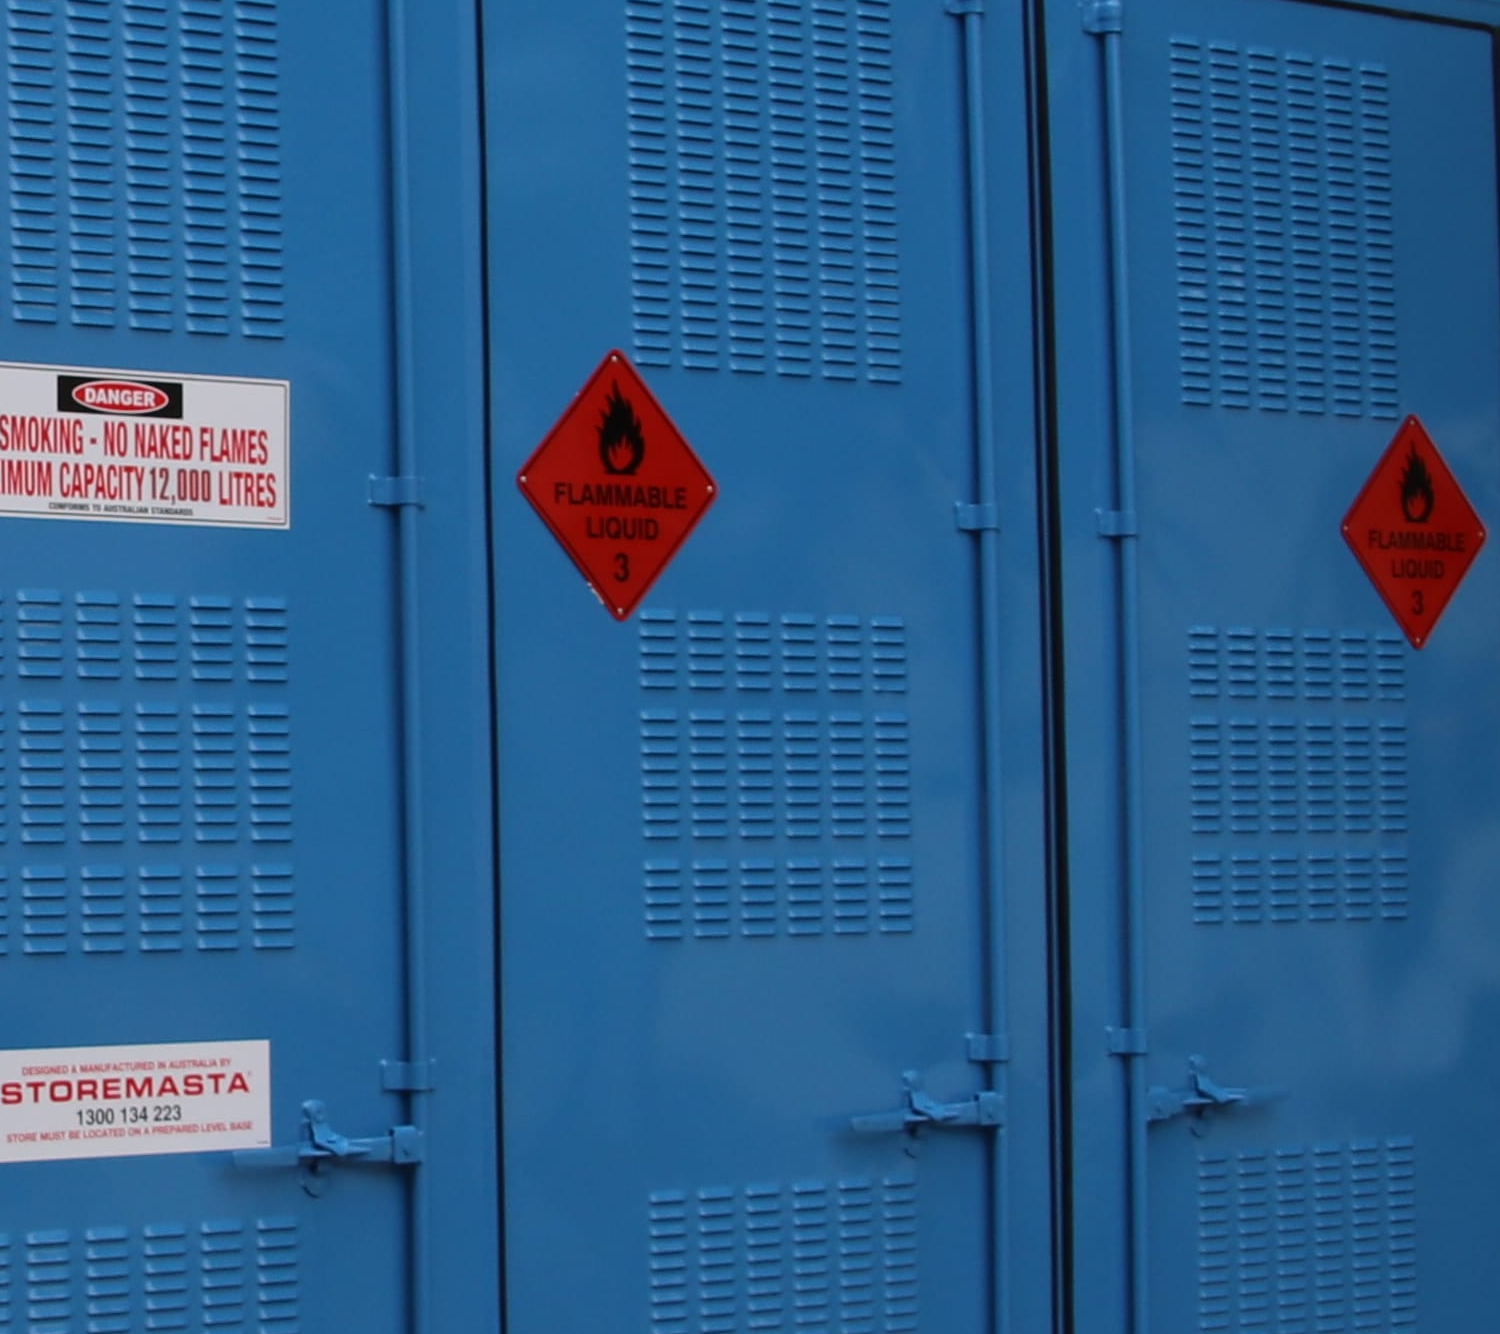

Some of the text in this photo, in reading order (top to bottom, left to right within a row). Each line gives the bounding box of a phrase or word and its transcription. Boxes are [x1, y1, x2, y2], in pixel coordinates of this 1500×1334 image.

[84, 387, 156, 408] DANGER
[0, 415, 83, 455] SMOKING
[104, 421, 127, 457] NO
[134, 423, 192, 460] NAKED
[200, 427, 268, 465] FLAMES
[59, 462, 145, 500] CAPACITY
[150, 468, 210, 505] 12,000
[219, 472, 276, 508] LITRES
[555, 483, 687, 509] FLAMMABLE
[587, 517, 659, 540] LIQUID
[1368, 530, 1465, 552] FLAMMABLE
[614, 553, 629, 582] 3
[1392, 559, 1444, 580] LIQUID
[1412, 591, 1424, 615] 3
[22, 1066, 69, 1076] DESIGNED
[80, 1062, 155, 1073] MANUFACTURED
[169, 1059, 217, 1069] AUSTRALIA
[220, 1058, 231, 1067] BY
[1, 1072, 249, 1105] STOREMASTA
[76, 1105, 182, 1125] 1300 134 223
[7, 1134, 37, 1143] STORE
[40, 1132, 66, 1141] MUST
[69, 1131, 80, 1139] BE
[83, 1128, 125, 1139] LOCATED
[128, 1127, 141, 1136] ON
[152, 1124, 199, 1135] PREPARED
[201, 1123, 227, 1132] LEVEL
[230, 1121, 253, 1131] BASE
